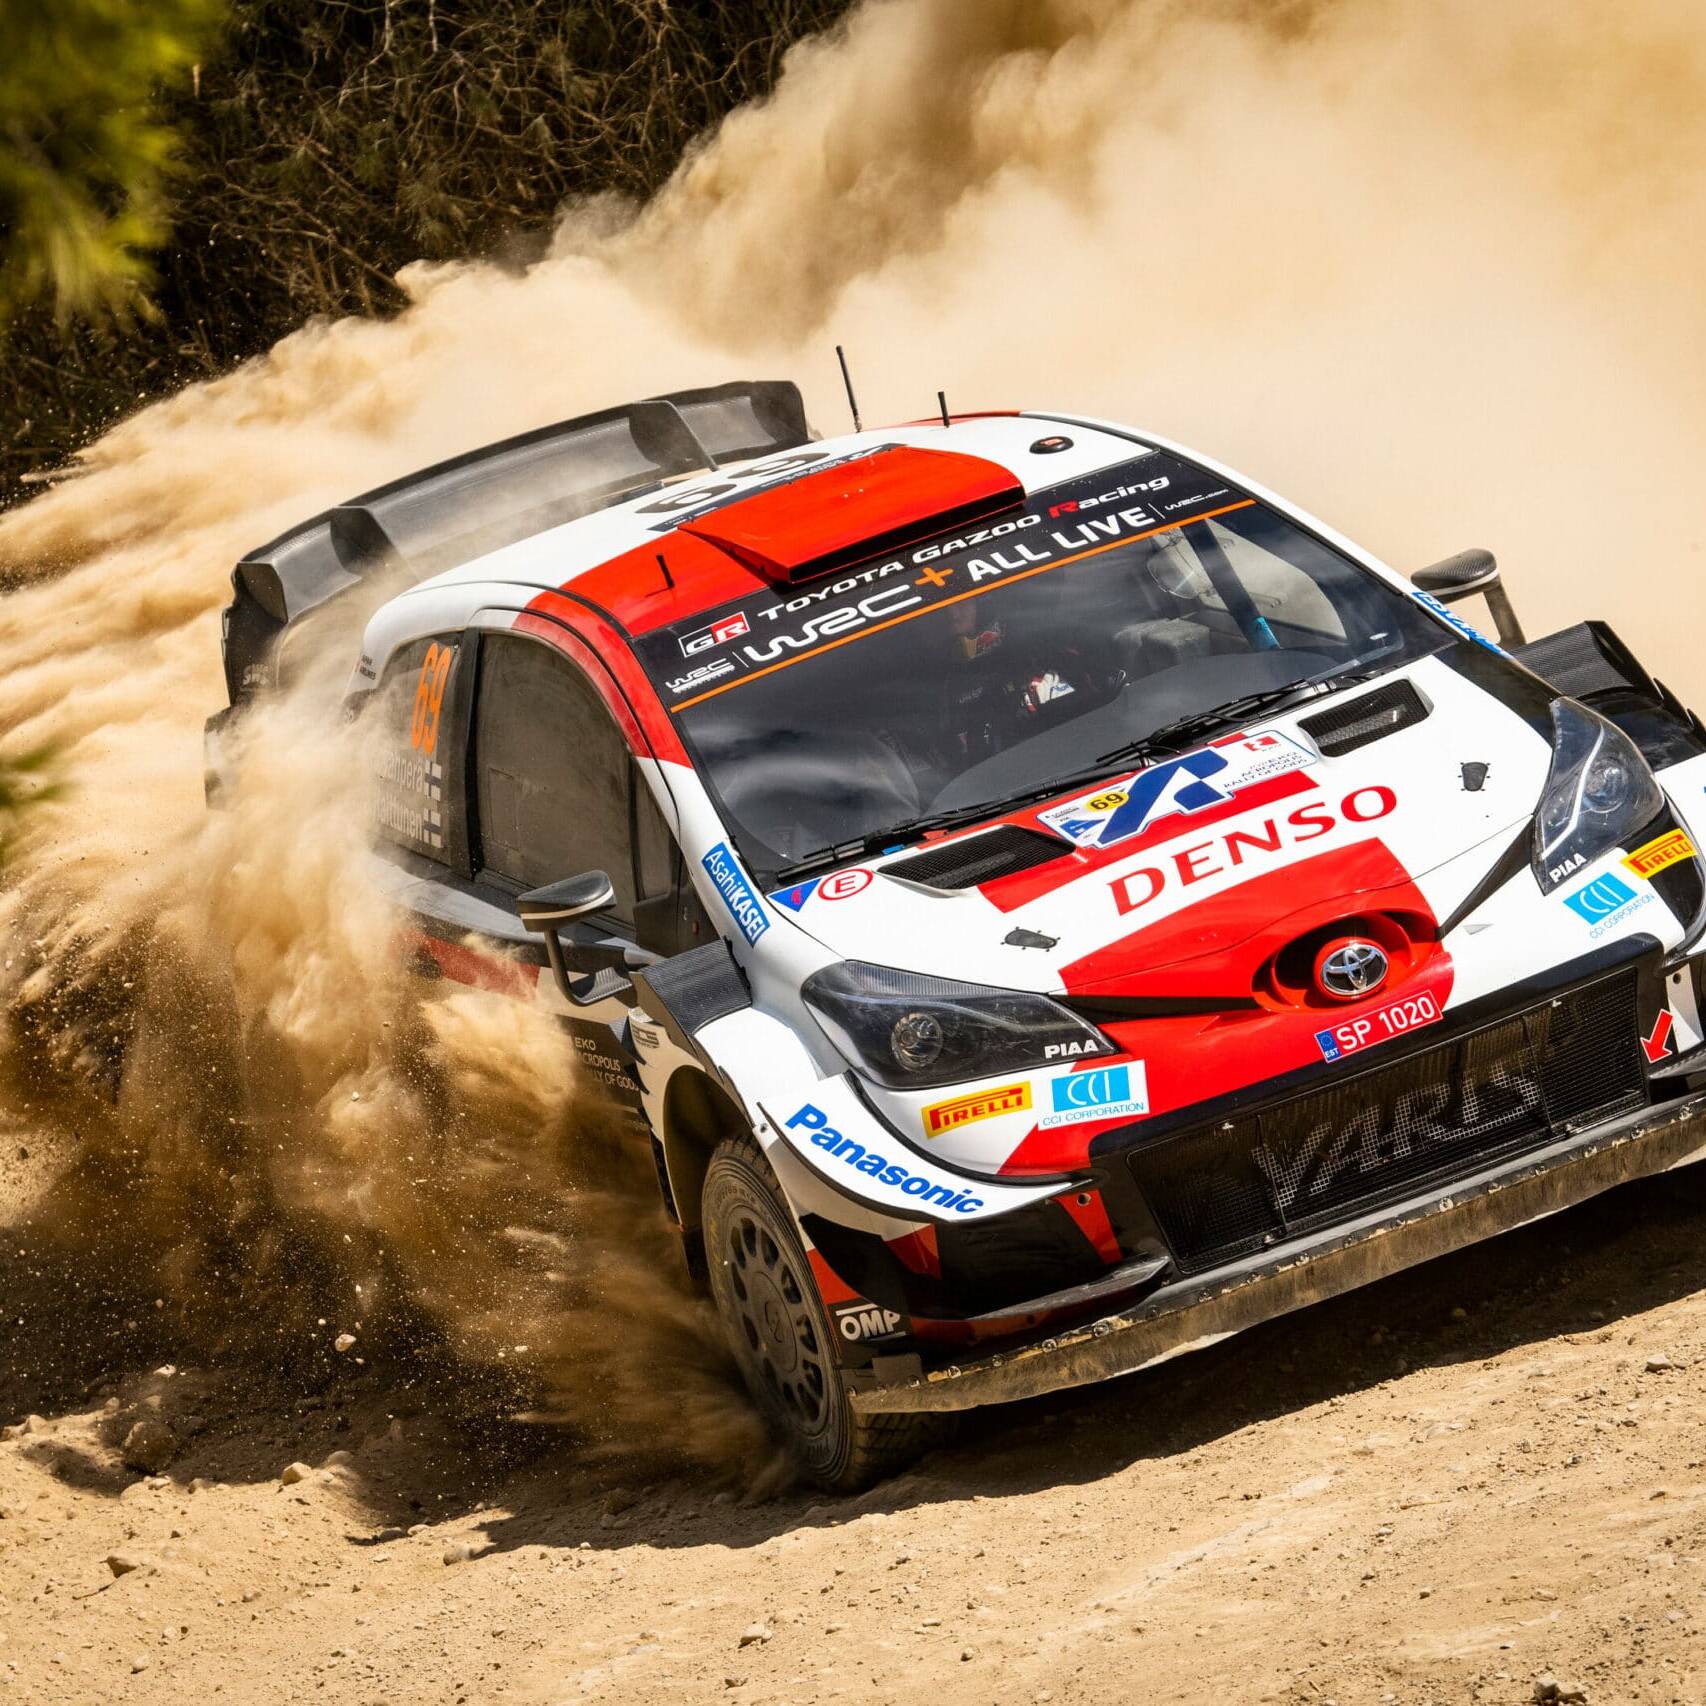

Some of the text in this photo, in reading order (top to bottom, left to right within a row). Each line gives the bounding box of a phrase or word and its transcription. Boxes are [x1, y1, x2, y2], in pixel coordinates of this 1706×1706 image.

[757, 475, 1171, 621] TOYOTA GAZOO Racing
[967, 537, 1052, 583] ALL
[1058, 506, 1156, 551] LIVE
[685, 621, 746, 654] GR
[665, 658, 732, 689] WRC
[411, 642, 451, 758] 69
[1090, 793, 1124, 810] 69
[1105, 785, 1399, 917] DENSO
[1548, 852, 1588, 884] PIAA
[1629, 833, 1696, 875] PIRELLI
[1602, 892, 1656, 930] CORPORATION
[1336, 996, 1436, 1051] SP 1020
[574, 1036, 597, 1052] EKO
[1044, 1039, 1100, 1060] PIAA
[1324, 1047, 1340, 1060] EST
[928, 1086, 1025, 1132] PIRELLI
[1042, 1101, 1146, 1127] CCI CORPORATION
[784, 1102, 985, 1214] Panasonic
[839, 1310, 901, 1342] OMP
